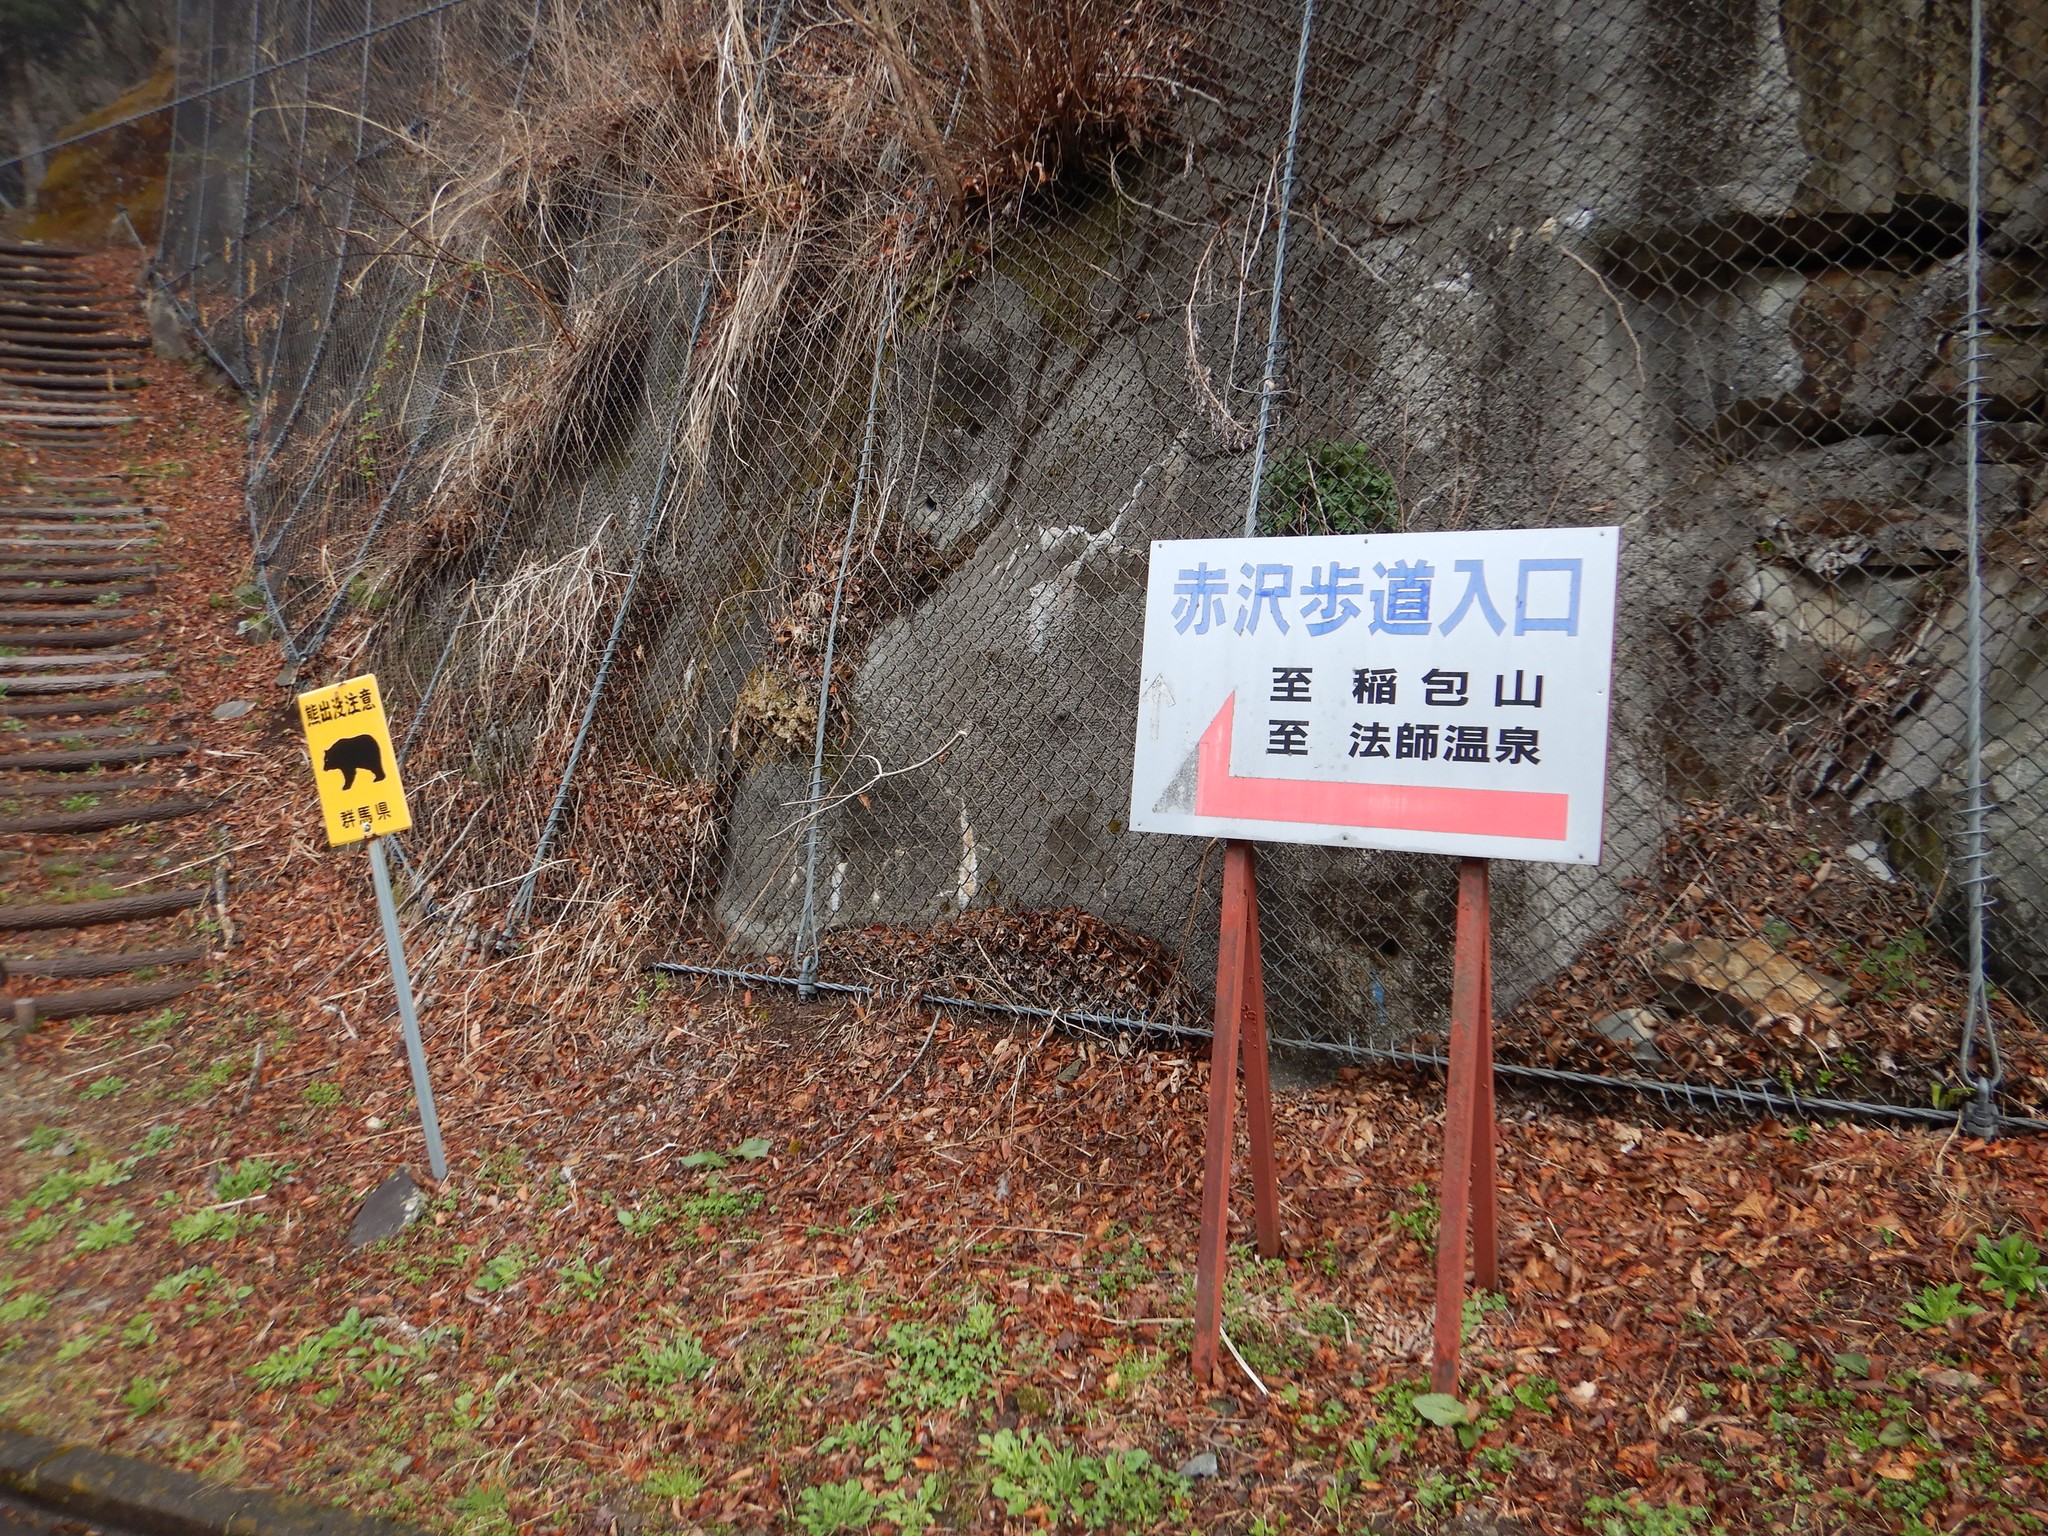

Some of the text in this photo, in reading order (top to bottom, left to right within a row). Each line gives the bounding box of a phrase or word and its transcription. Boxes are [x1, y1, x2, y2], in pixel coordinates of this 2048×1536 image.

[1171, 558, 1584, 637] 赤沢歩道入口
[305, 688, 376, 727] 熊出没注意
[1270, 666, 1543, 708] 至 稲包山
[1266, 719, 1542, 765] 至 法師温泉
[340, 801, 392, 829] 群馬県
